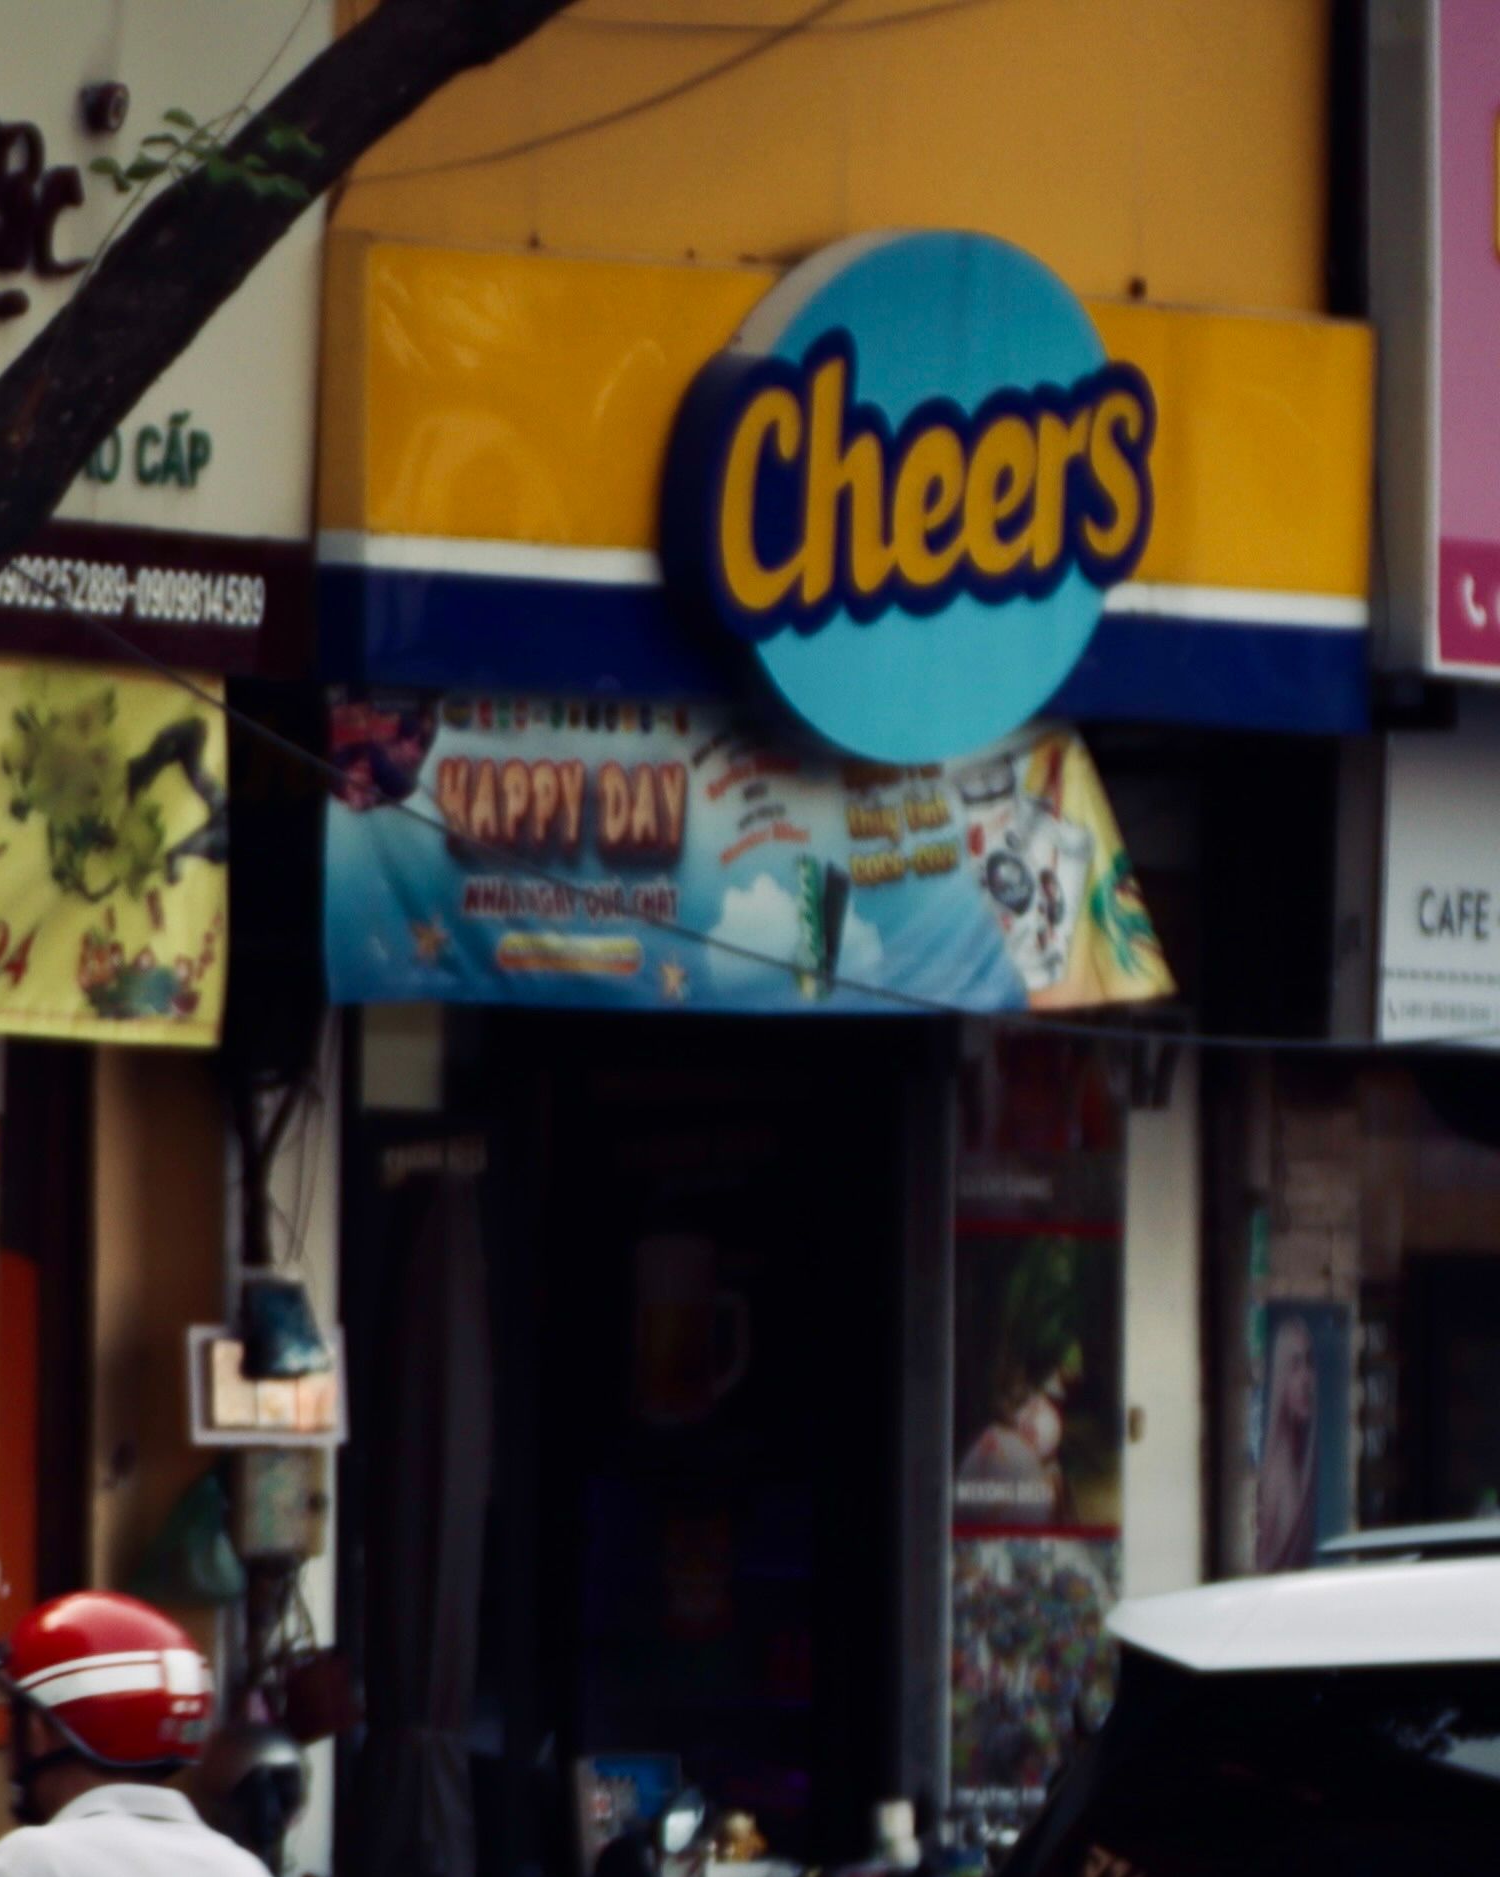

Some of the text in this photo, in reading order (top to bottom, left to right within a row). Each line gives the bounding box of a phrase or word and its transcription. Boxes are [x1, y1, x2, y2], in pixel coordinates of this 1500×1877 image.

[717, 355, 1146, 614] Cheers
[436, 755, 587, 847] HAPPY
[598, 758, 689, 848] DAY
[1417, 885, 1492, 943] CAFE
